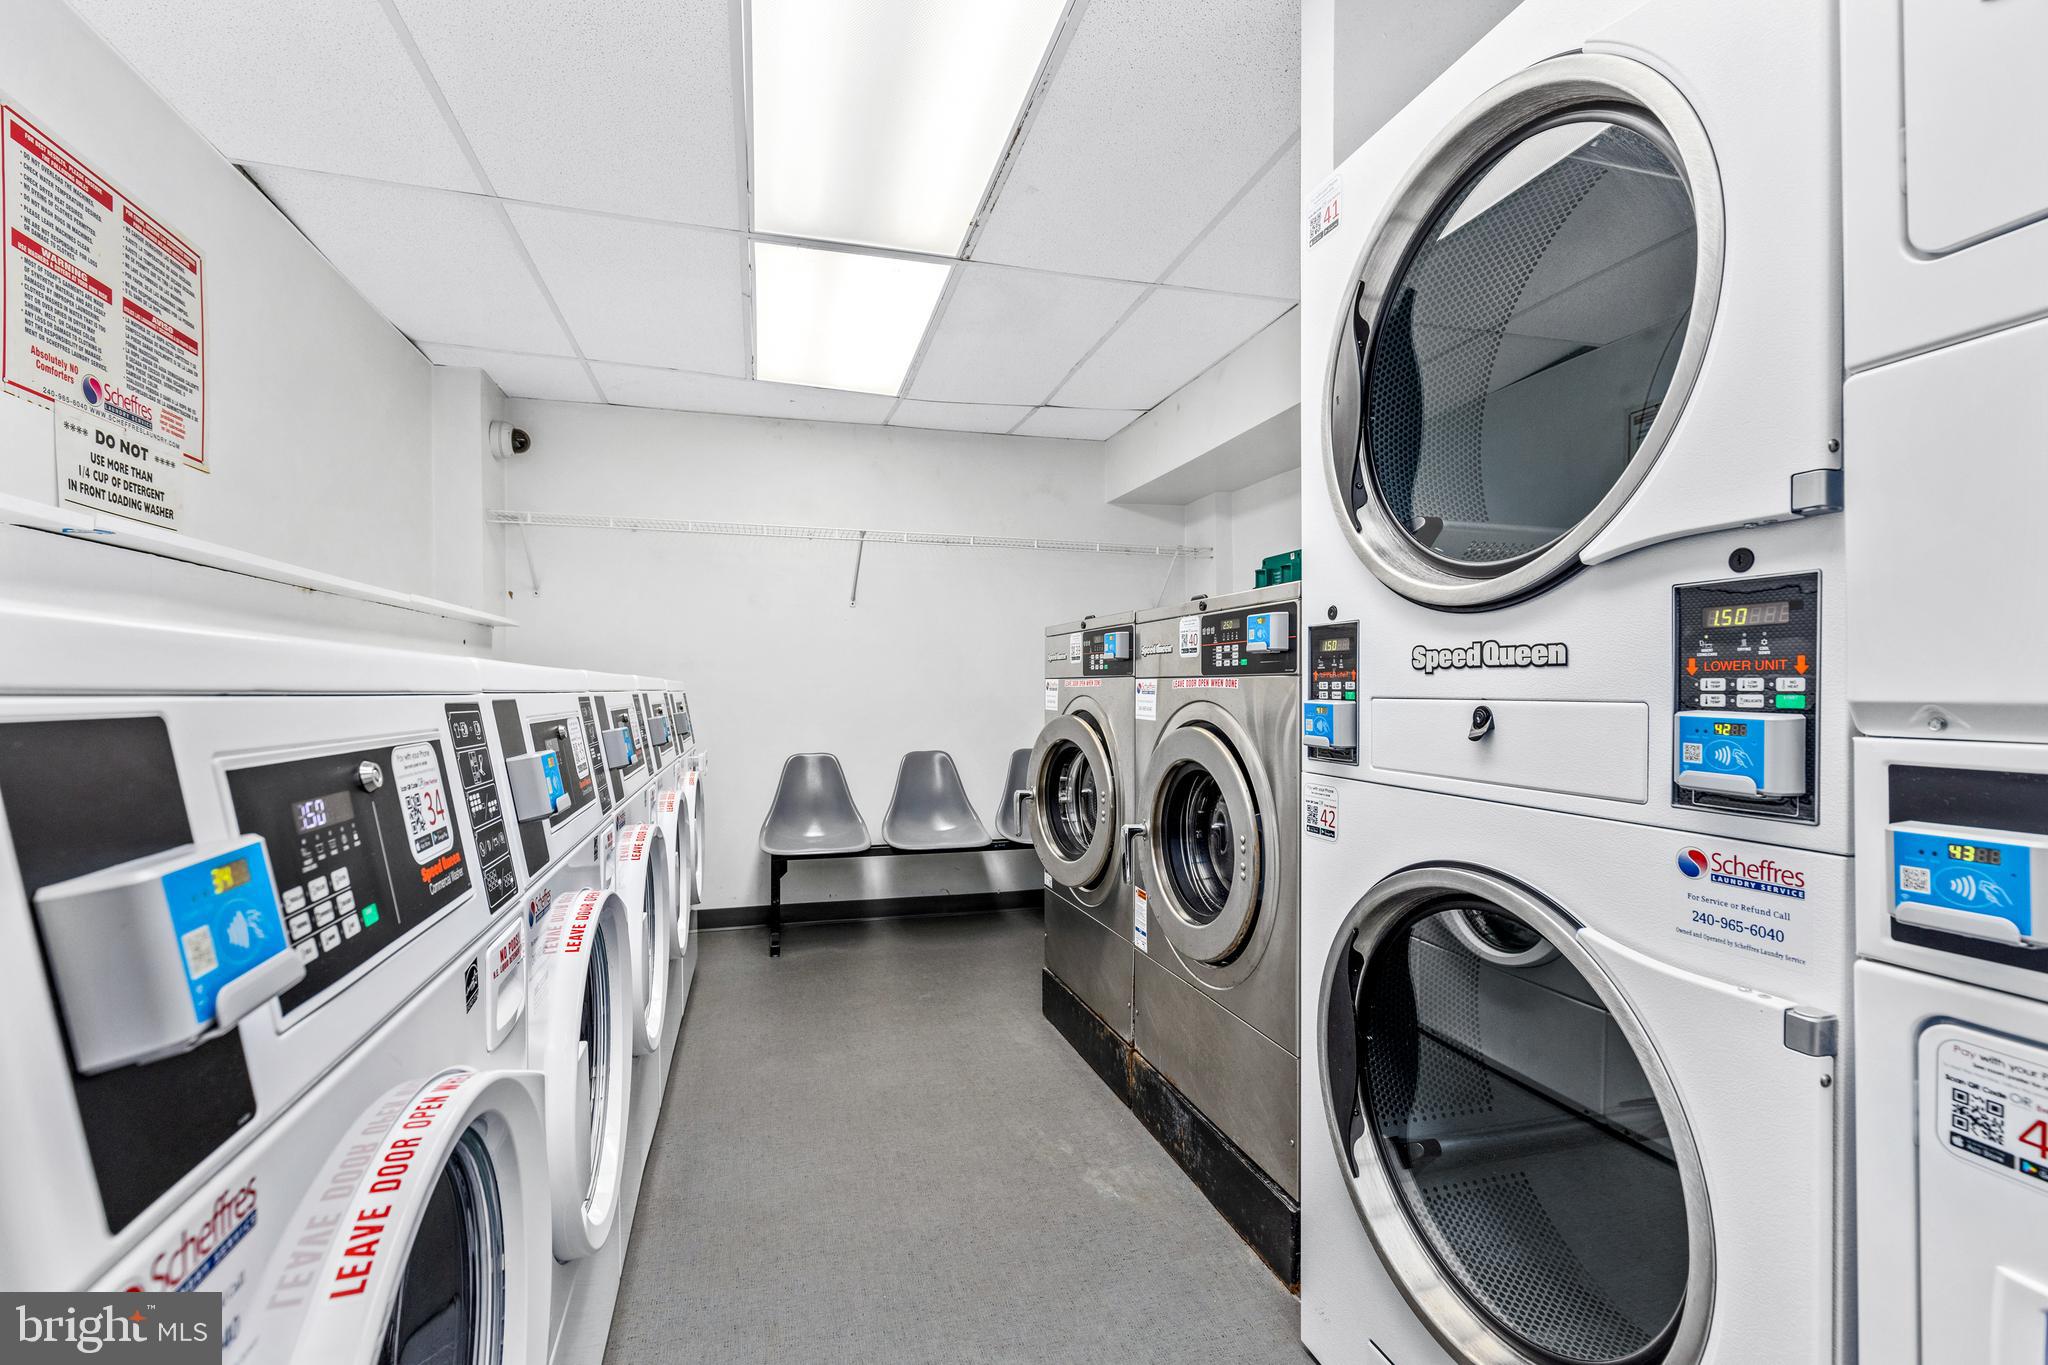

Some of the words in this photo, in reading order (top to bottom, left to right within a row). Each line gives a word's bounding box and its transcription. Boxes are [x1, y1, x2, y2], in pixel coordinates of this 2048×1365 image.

[1324, 200, 1339, 224] 41
[41, 248, 88, 282] WARNING
[31, 345, 67, 372] Absolutely
[70, 363, 78, 375] NO
[36, 359, 74, 384] Comforters
[42, 387, 88, 411] 240-965-6040
[104, 384, 152, 420] Scheffres
[104, 404, 131, 421] LAUNDRY
[132, 414, 152, 428] SERVICE
[95, 430, 115, 449] DO
[120, 440, 148, 460] NOT
[90, 452, 105, 466] USE
[108, 458, 128, 474] MORE
[131, 467, 152, 483] THAN
[78, 465, 90, 478] 1/4
[93, 471, 108, 484] CUP
[112, 476, 121, 488] OF
[124, 480, 164, 502] DETERGENT
[68, 478, 77, 491] IN
[80, 483, 107, 500] FRONT
[108, 492, 142, 511] LOADING
[144, 503, 174, 520] WASHER
[1188, 633, 1198, 646] 40
[1703, 660, 1751, 672] LOWER
[1755, 659, 1788, 671] UNIT
[1174, 680, 1184, 688] LEAVE
[1186, 680, 1196, 688] DOOR
[1198, 679, 1209, 687] OPEN
[1211, 679, 1223, 687] WHEN
[1225, 679, 1238, 688] DONE
[1714, 724, 1731, 736] 42
[424, 789, 445, 825] 34
[1320, 809, 1335, 828] 42
[631, 844, 643, 861] LEAVE
[1949, 845, 1975, 862] 43
[421, 858, 444, 883] Speed
[441, 852, 461, 870] Queen
[1711, 852, 1805, 888] Scheffres
[1712, 875, 1756, 889] LAUNDRY
[1760, 884, 1804, 898] SERVICE
[575, 902, 595, 920] DOOR
[1687, 893, 1699, 901] For
[1701, 895, 1728, 908] Service
[1741, 904, 1771, 917] Refund
[1773, 911, 1790, 921] Call
[565, 924, 586, 952] LEAVE
[1692, 910, 1784, 942] 240-965-6040
[500, 946, 507, 962] NO
[1676, 927, 1692, 936] Owned
[1703, 933, 1726, 945] Operated
[1727, 939, 1733, 947] by
[1734, 941, 1759, 953] Scheffres
[1761, 948, 1783, 960] Laundry
[1785, 954, 1806, 965] Service
[1953, 1045, 1976, 1060] Pay
[1980, 1055, 2005, 1067] with
[2009, 1064, 2037, 1077] your
[1945, 1073, 1966, 1085] Scan
[1968, 1081, 1980, 1090] QR
[1982, 1086, 2007, 1099] Code
[2009, 1093, 2032, 1106] OR
[1967, 1144, 1981, 1154] App
[1983, 1150, 2004, 1163] Store
[329, 1205, 392, 1299] LEAVE
[368, 1136, 423, 1193] DOOR
[403, 1095, 450, 1129] OPEN
[152, 1176, 256, 1286] Scheffres
